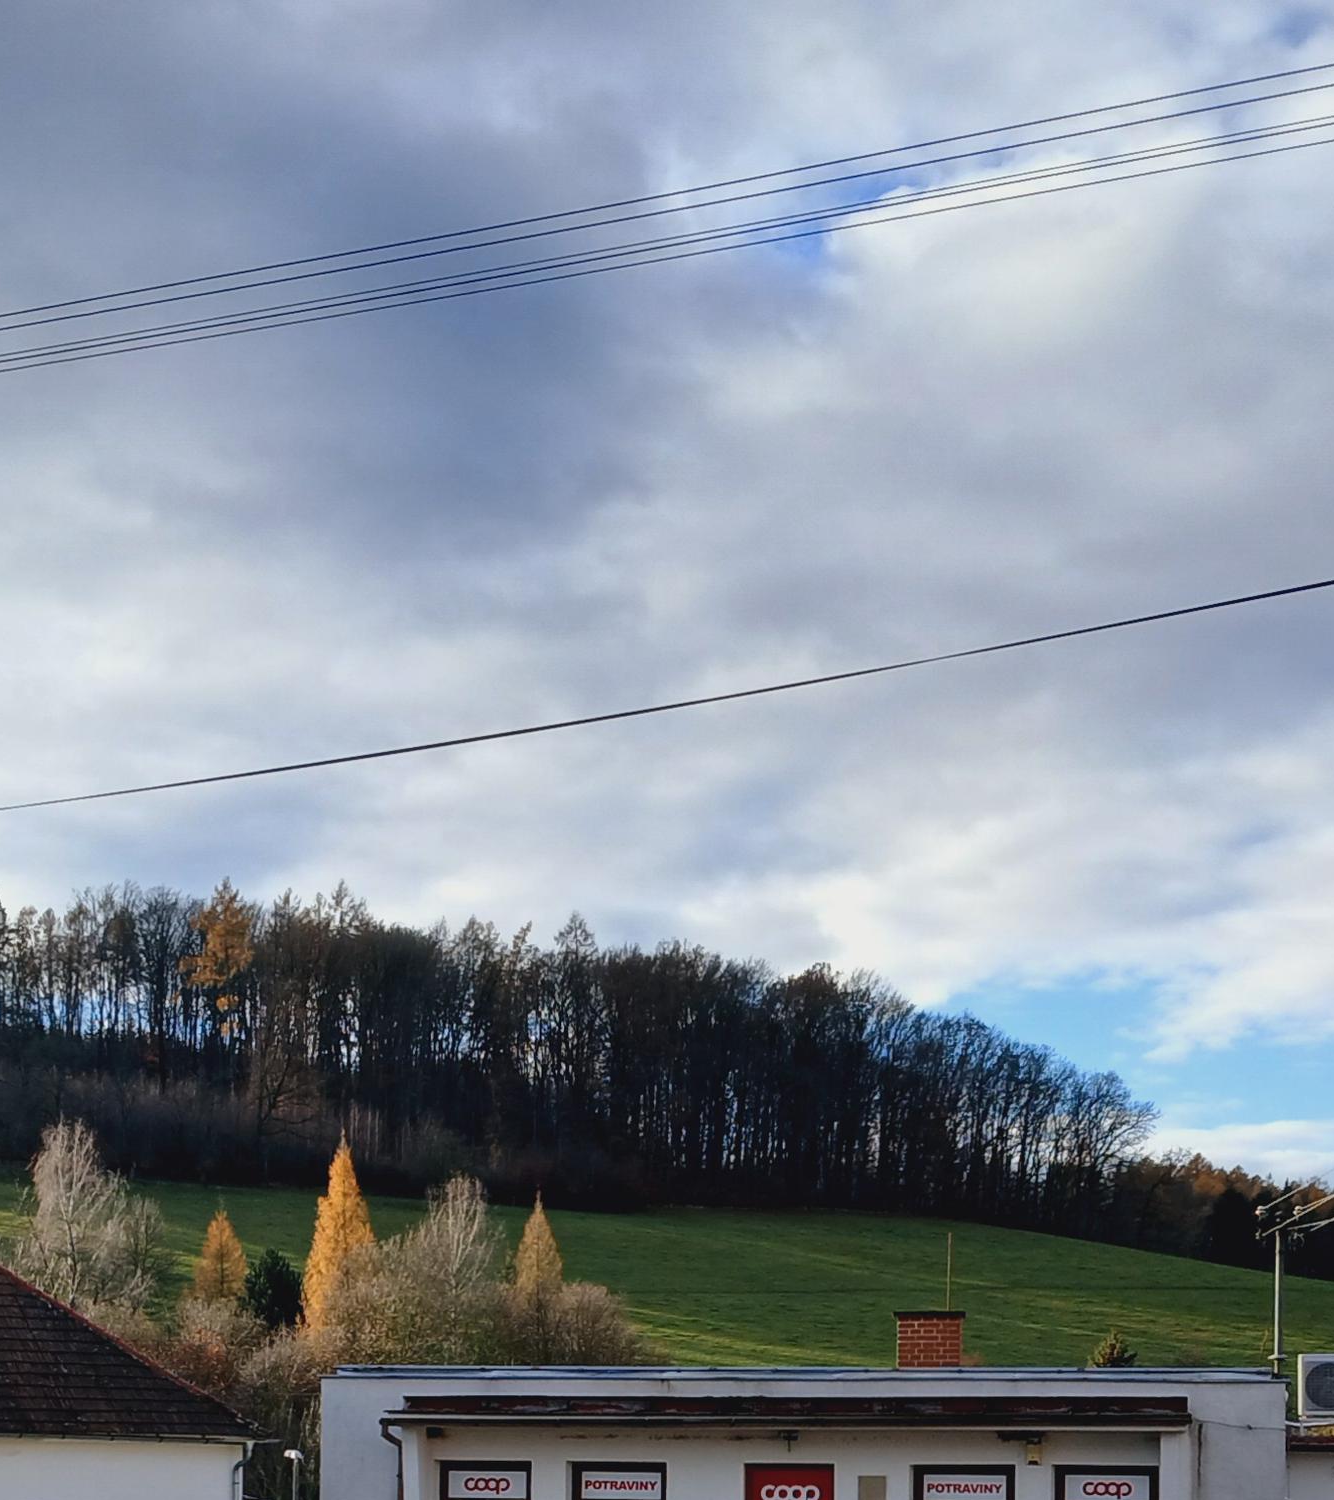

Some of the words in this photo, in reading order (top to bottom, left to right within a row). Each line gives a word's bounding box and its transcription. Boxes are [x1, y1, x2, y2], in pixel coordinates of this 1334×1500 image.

[464, 1477, 510, 1494] coop
[584, 1480, 658, 1491] POTRAVINY
[926, 1483, 1003, 1494] POTRAVINY
[1082, 1481, 1132, 1500] coop
